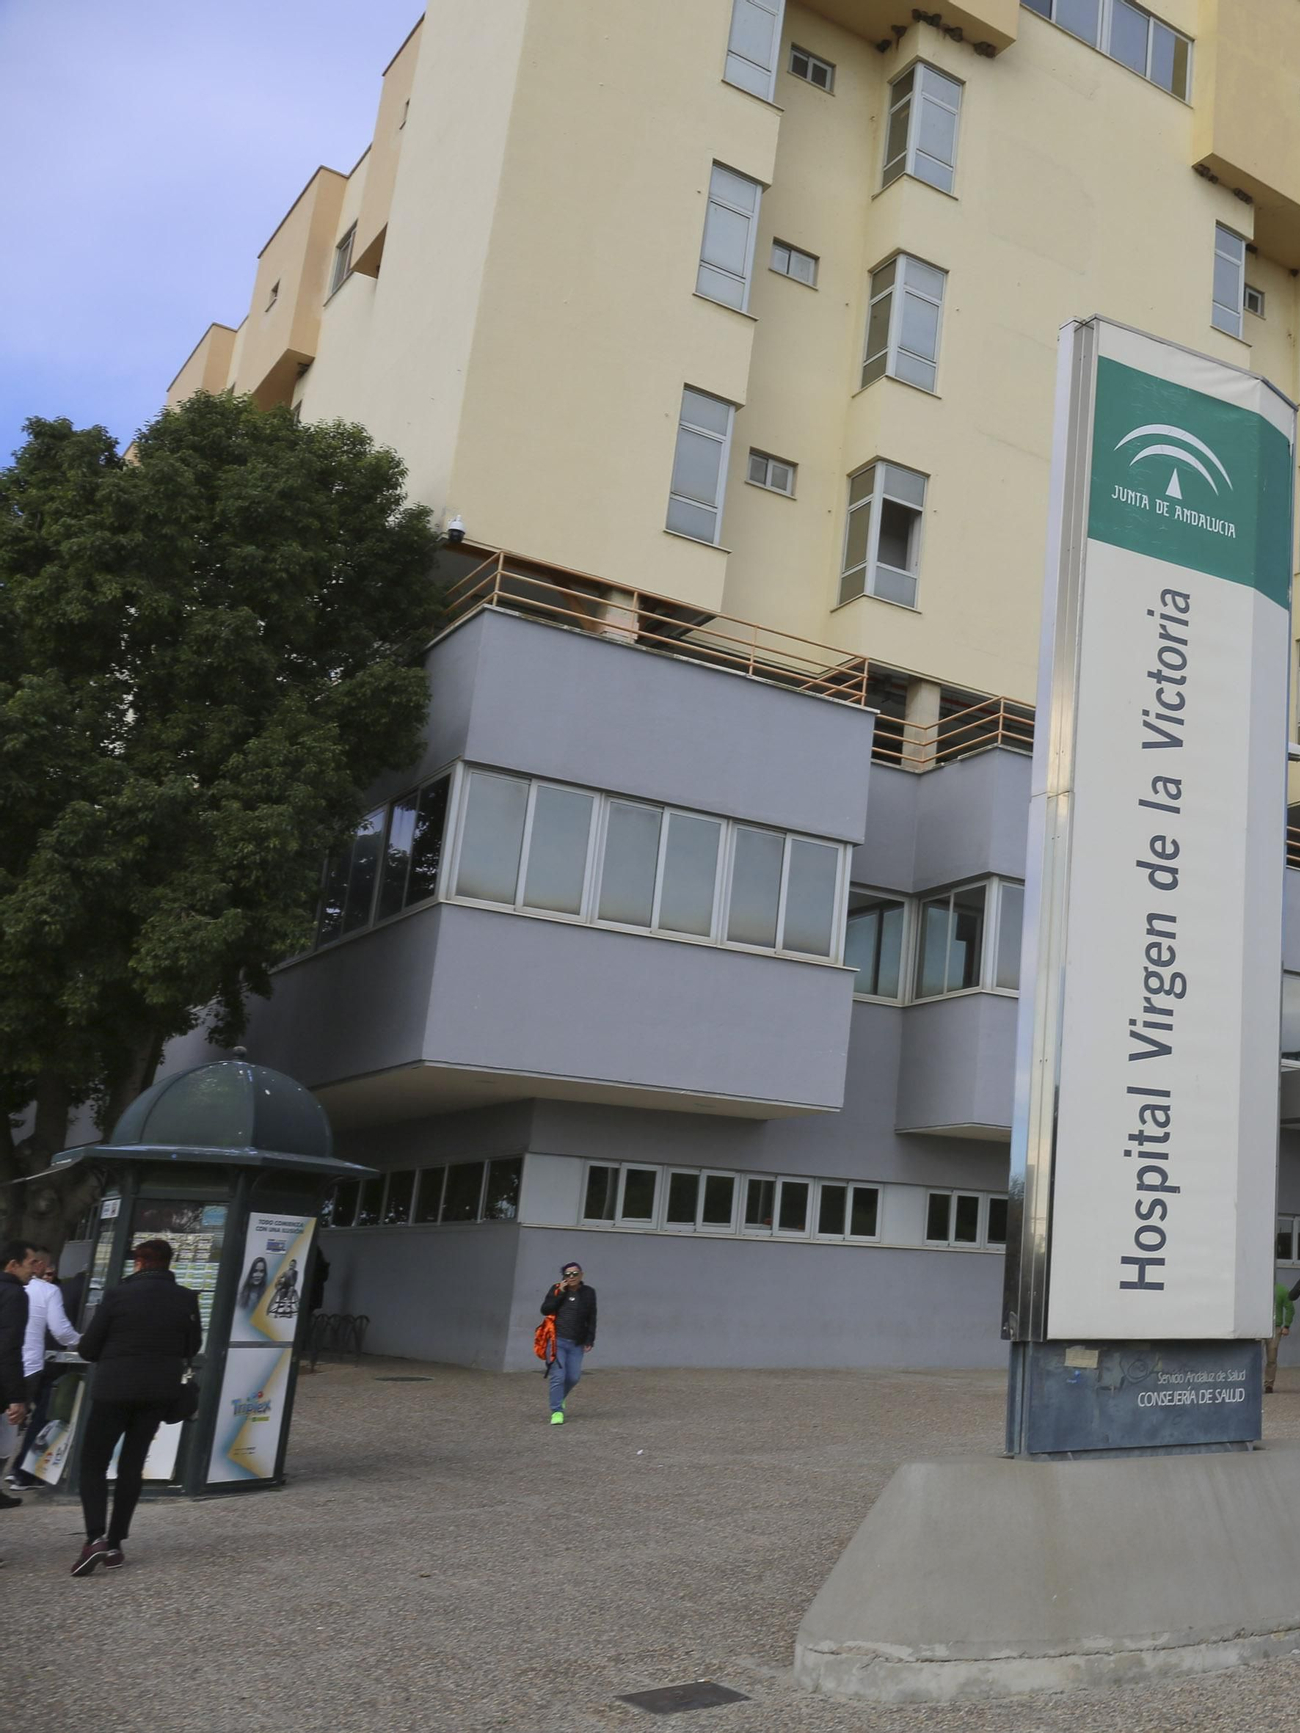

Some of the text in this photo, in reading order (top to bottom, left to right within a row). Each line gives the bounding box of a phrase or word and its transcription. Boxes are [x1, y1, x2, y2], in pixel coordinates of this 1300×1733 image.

[1111, 485, 1236, 539] JUNTA DE ANDALUCIA
[1119, 588, 1191, 1291] Hospital Virgen de la Victoria
[1215, 1370, 1227, 1382] de
[1227, 1369, 1247, 1382] Salud
[231, 1397, 271, 1416] Triplex
[1137, 1385, 1245, 1408] CONSEJERÍA DE SALUD
